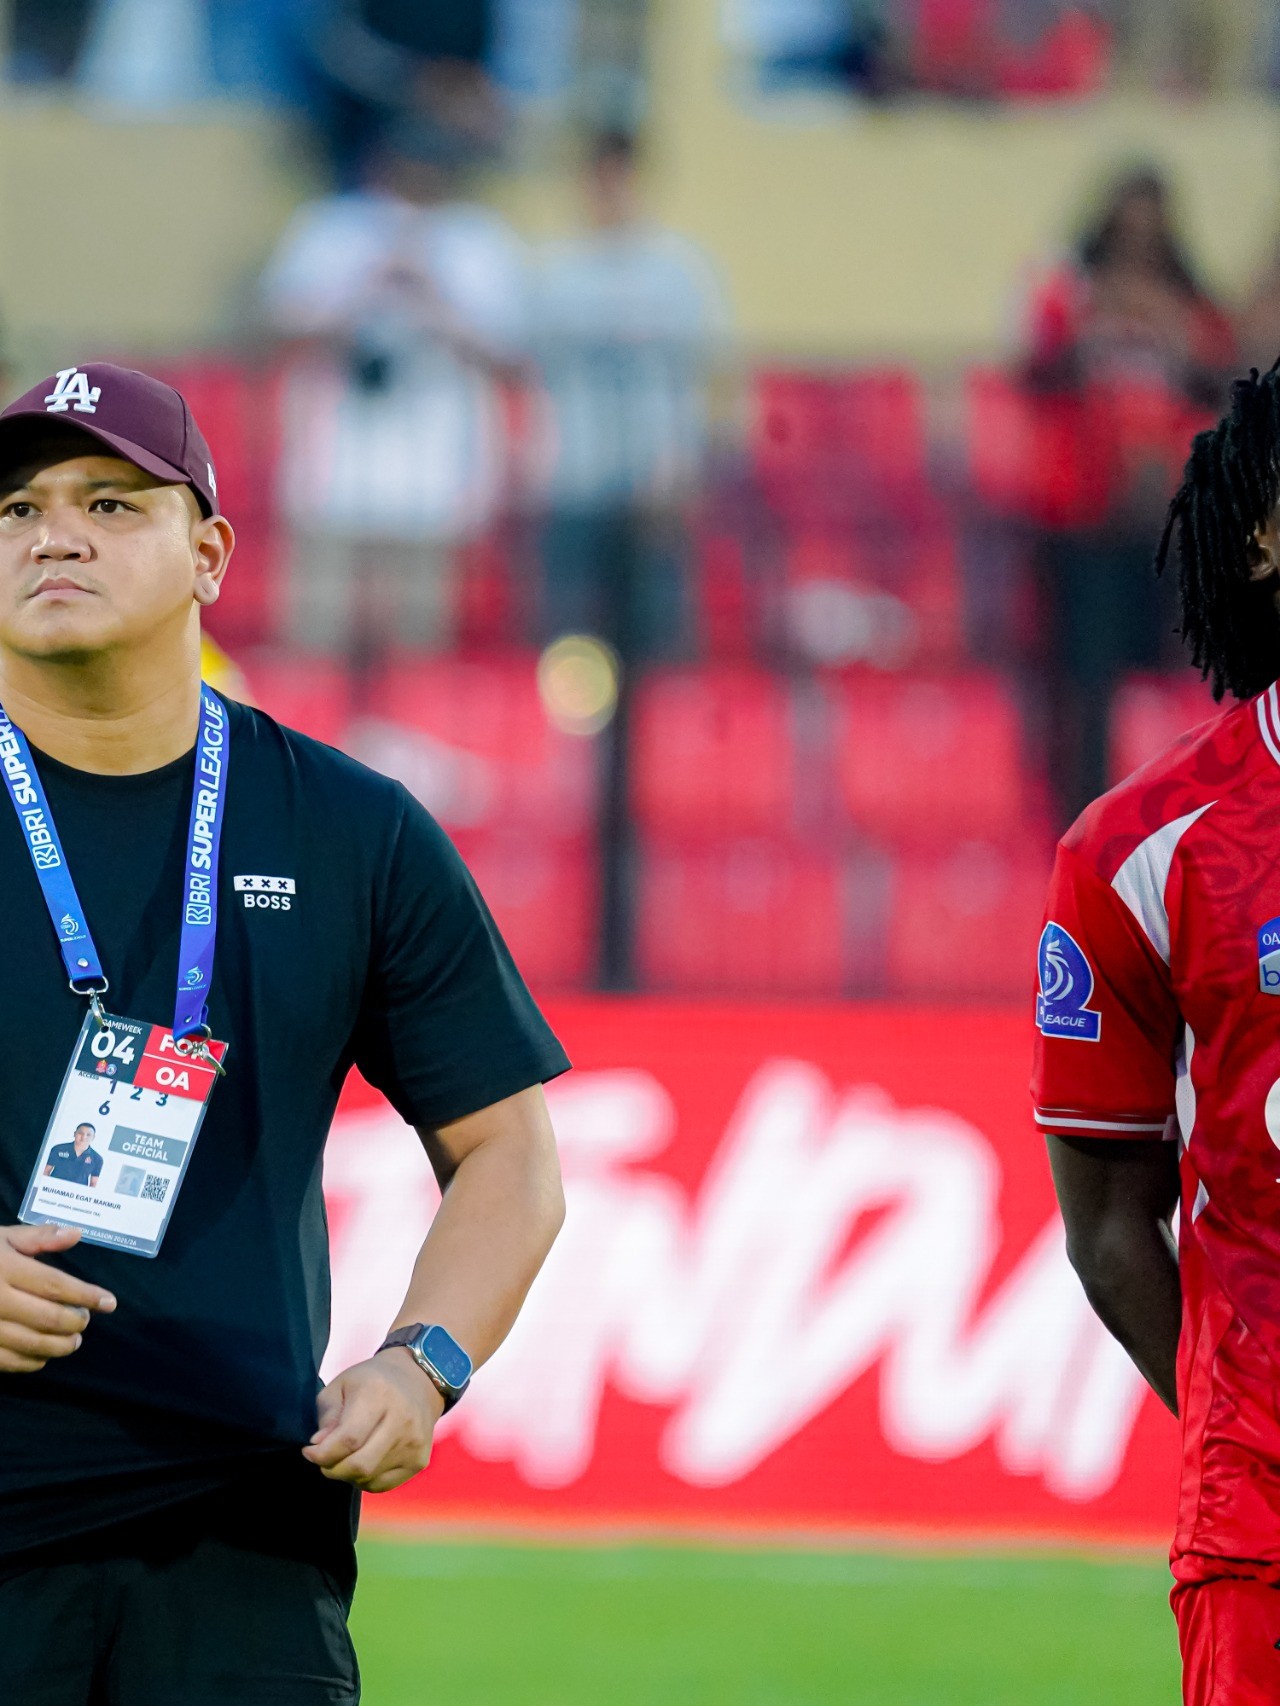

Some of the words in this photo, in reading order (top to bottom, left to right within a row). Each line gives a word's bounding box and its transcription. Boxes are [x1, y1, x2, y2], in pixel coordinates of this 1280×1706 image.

[44, 367, 101, 414] LA
[22, 808, 51, 845] BRI
[189, 872, 211, 904] BRI
[244, 894, 291, 911] BOSS
[102, 1019, 143, 1035] GAMEWEEK
[91, 1031, 135, 1065] 04
[156, 1067, 190, 1091] OA
[109, 1079, 118, 1095] 1
[130, 1086, 144, 1101] 2
[155, 1092, 169, 1107] 3
[98, 1101, 111, 1116] 6
[122, 1142, 168, 1161] OFFICIAL
[135, 1134, 164, 1150] TEAM
[91, 1230, 113, 1241] SEASON
